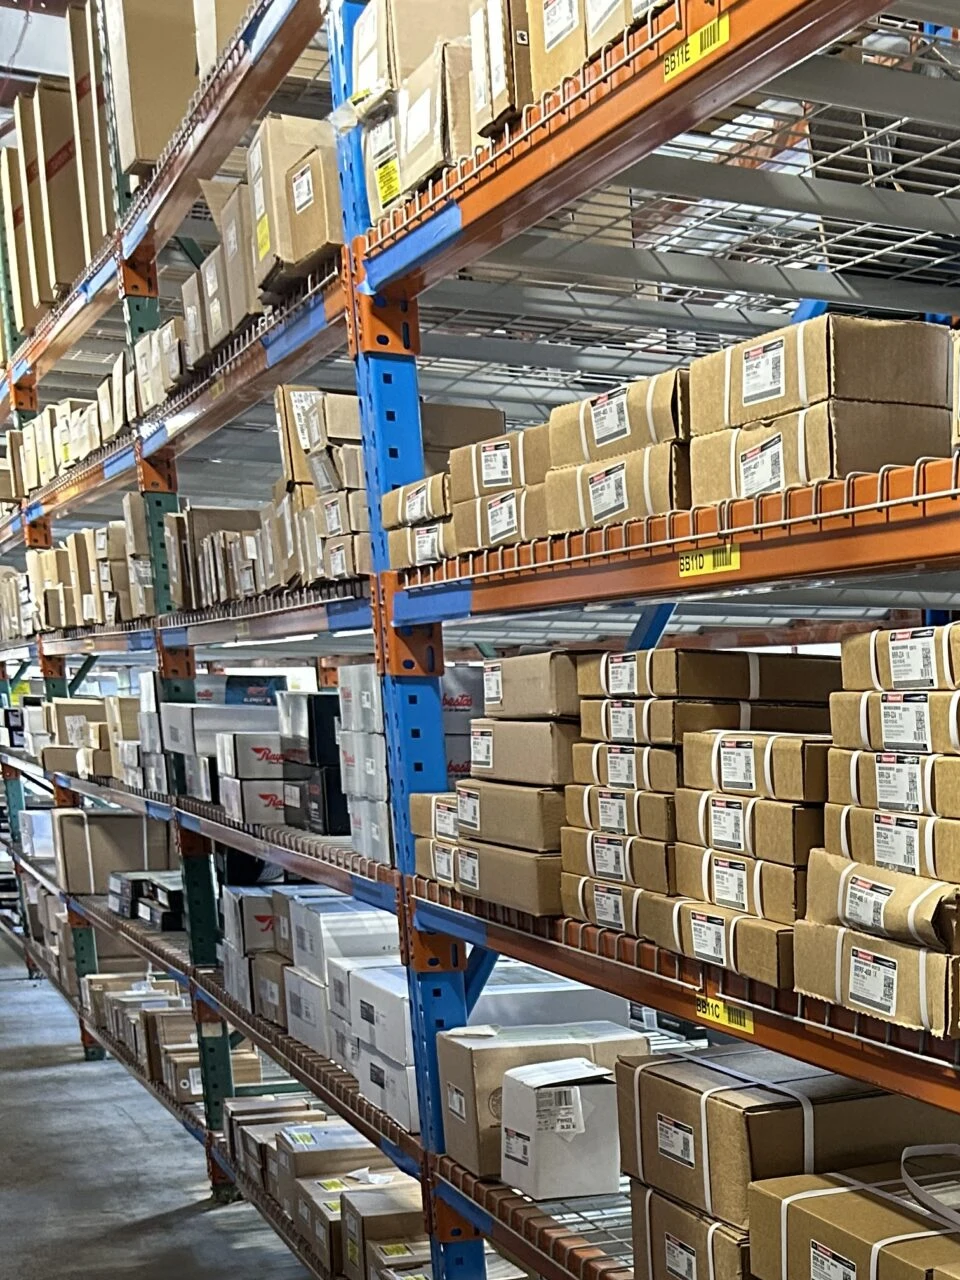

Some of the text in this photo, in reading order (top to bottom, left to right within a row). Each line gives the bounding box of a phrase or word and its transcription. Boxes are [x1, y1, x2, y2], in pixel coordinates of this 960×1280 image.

[665, 43, 690, 75] BB11E
[680, 553, 704, 571] BB11D
[696, 998, 720, 1018] BB11C
